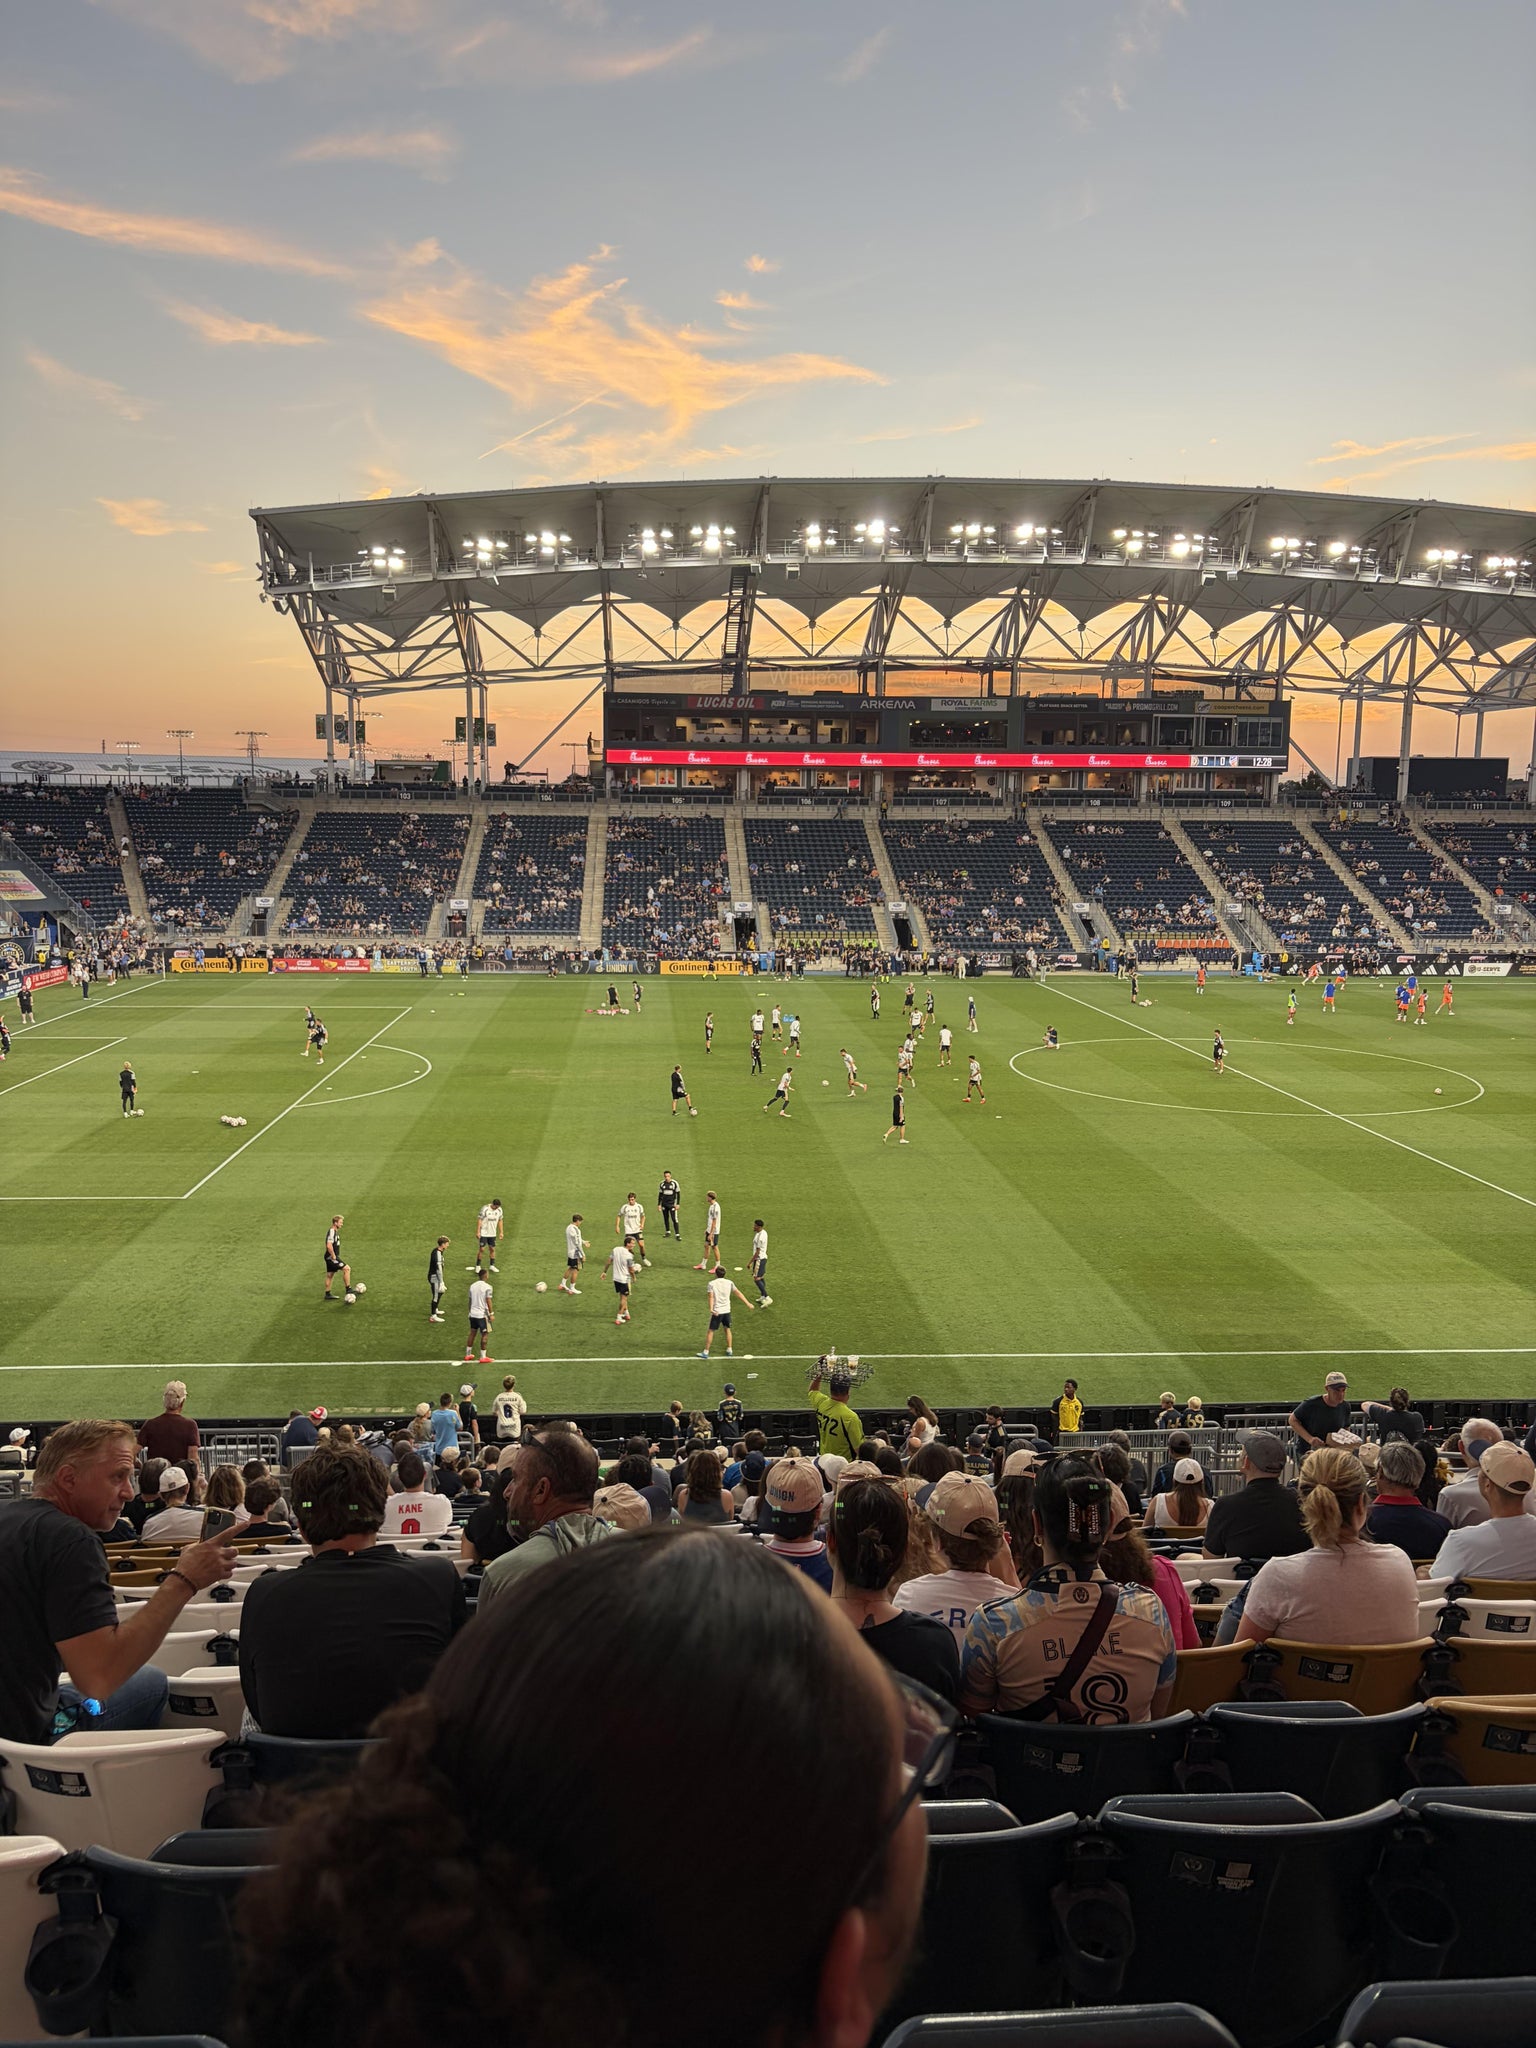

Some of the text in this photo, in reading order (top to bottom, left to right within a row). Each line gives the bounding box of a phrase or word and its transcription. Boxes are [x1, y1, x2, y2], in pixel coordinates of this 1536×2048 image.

[697, 697, 755, 708] LUCAS OIL
[860, 700, 916, 709] ARKEMA
[941, 699, 968, 707] ROYAL
[1203, 756, 1226, 765] 0 0
[243, 960, 264, 968] Tire
[606, 962, 628, 972] UNION
[769, 1484, 796, 1503] UNION
[398, 1503, 423, 1514] KANE
